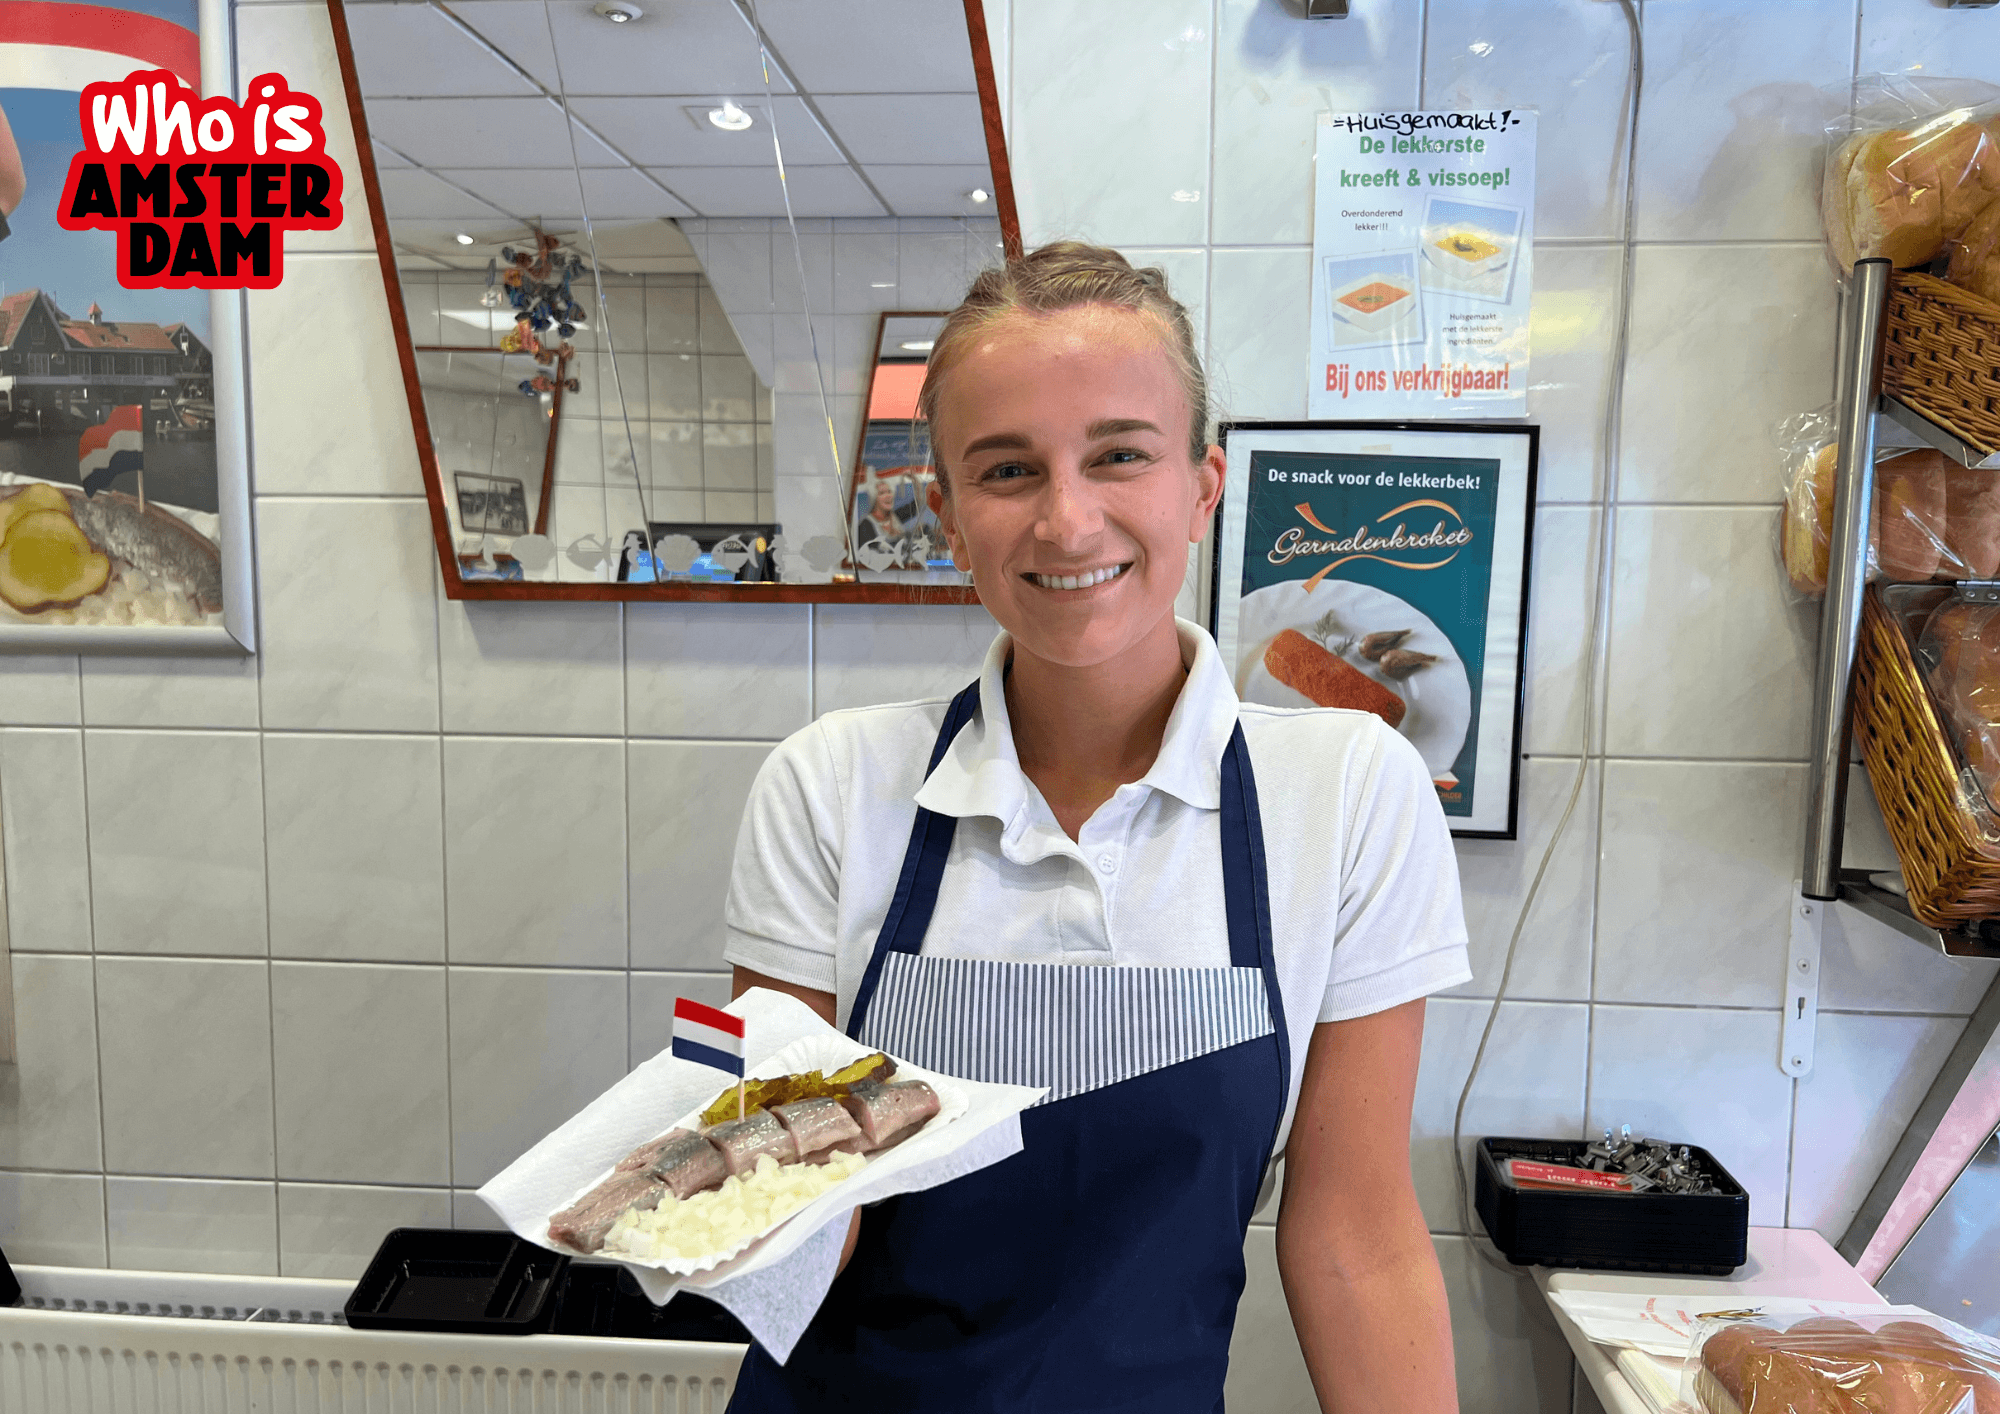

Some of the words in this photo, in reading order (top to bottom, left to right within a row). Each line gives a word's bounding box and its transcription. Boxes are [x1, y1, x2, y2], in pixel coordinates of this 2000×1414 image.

[1360, 136, 1385, 154] De
[1392, 136, 1486, 154] lekkerste
[1340, 169, 1400, 187] kreeft
[1406, 168, 1421, 187] &
[1428, 167, 1510, 190] vissoep!
[1341, 209, 1403, 218] Overdonderend
[1355, 223, 1388, 231] lekker!!!
[1449, 313, 1497, 322] Huisgemaakt
[1326, 364, 1349, 399] Bij
[1355, 370, 1387, 391] ons
[1393, 362, 1509, 398] verkrijgbaar!
[1268, 468, 1288, 482] De
[1291, 469, 1334, 485] snack
[1338, 474, 1371, 486] voor
[1375, 472, 1394, 487] de
[1398, 472, 1481, 490] lekkerbek!
[1267, 520, 1474, 565] Garnalenkroket
